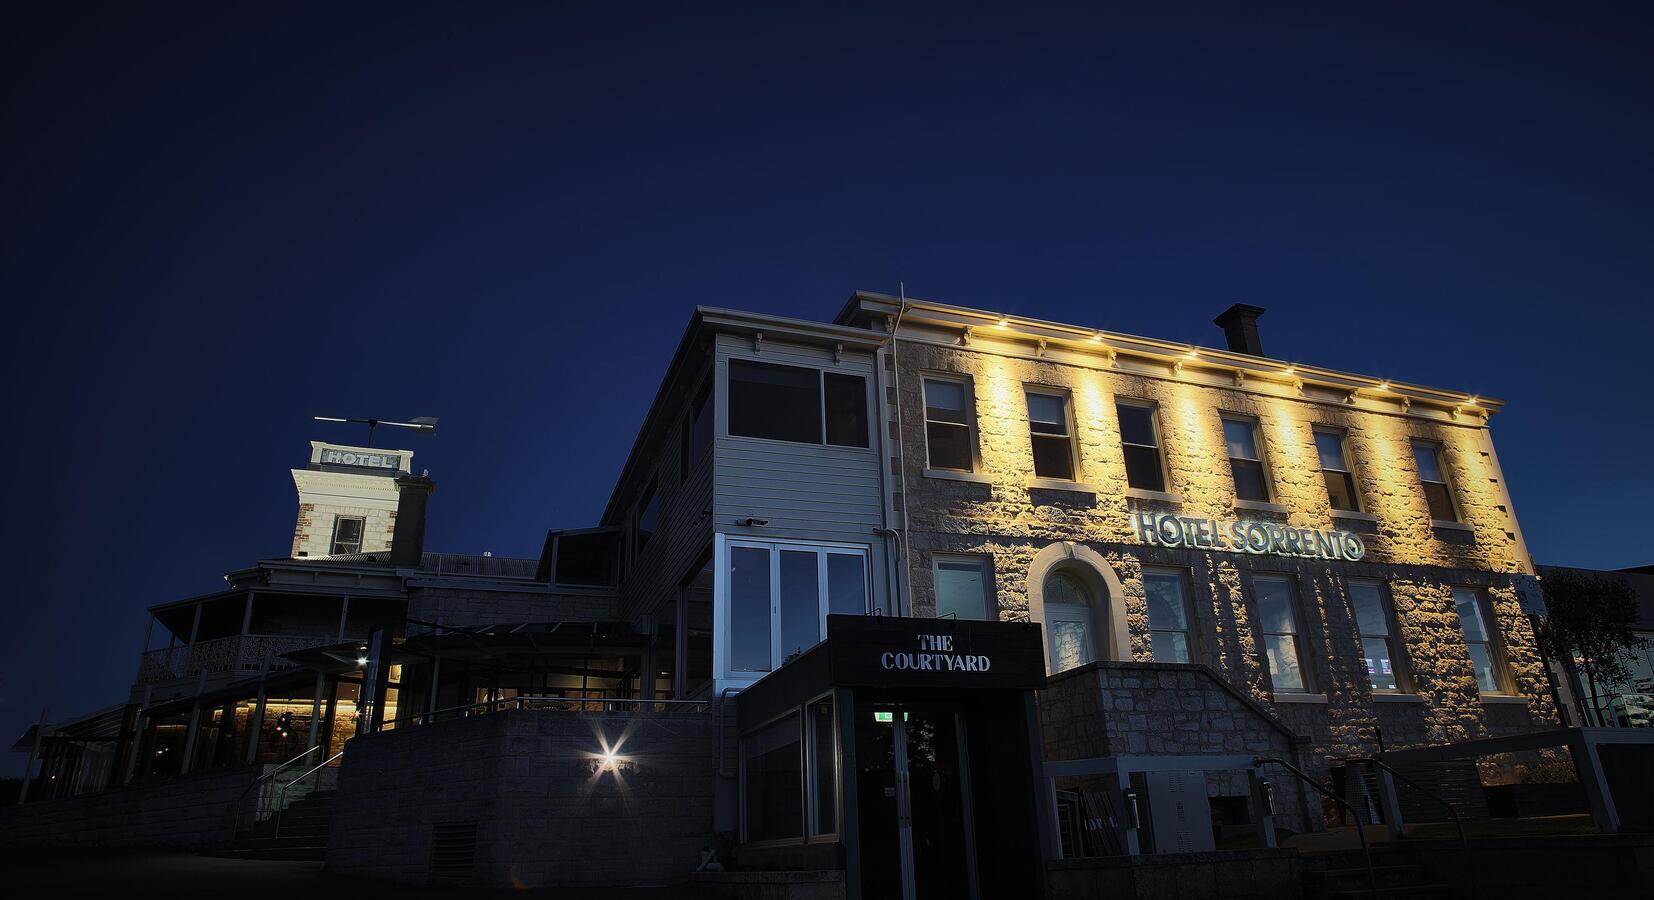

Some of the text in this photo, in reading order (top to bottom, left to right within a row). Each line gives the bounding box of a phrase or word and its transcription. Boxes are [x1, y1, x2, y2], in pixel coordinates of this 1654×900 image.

[327, 451, 393, 468] HOTEL
[1137, 512, 1366, 561] HOTEL SORRENTO
[917, 634, 953, 652] THE
[881, 652, 991, 672] COURTYARD
